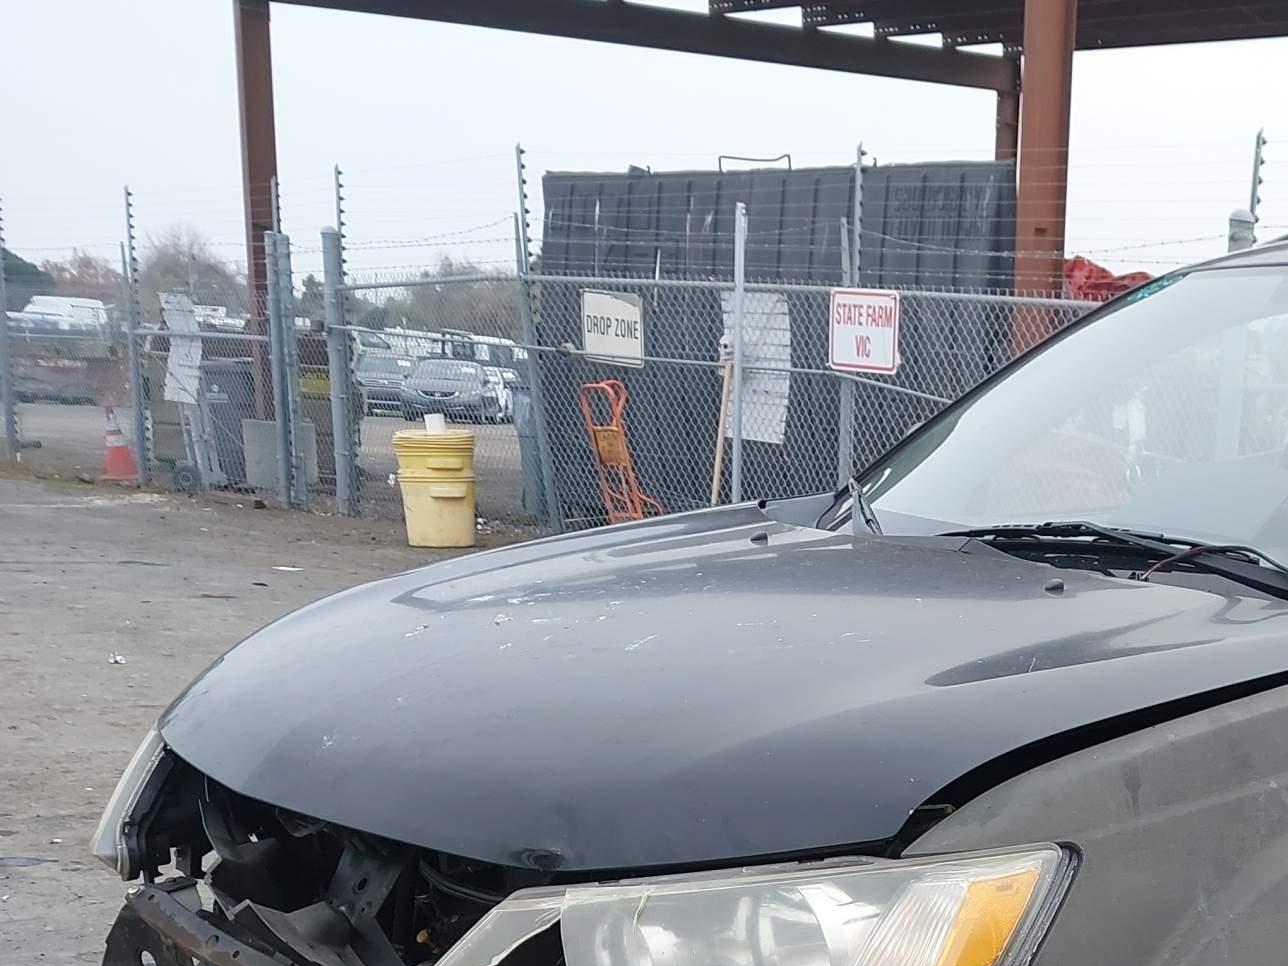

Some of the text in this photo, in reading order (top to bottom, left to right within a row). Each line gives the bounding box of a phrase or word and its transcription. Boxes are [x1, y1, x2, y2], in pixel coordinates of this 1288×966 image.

[586, 314, 639, 340] DROP ZONE
[836, 302, 892, 328] STATE FARM
[855, 335, 871, 358] VIC
